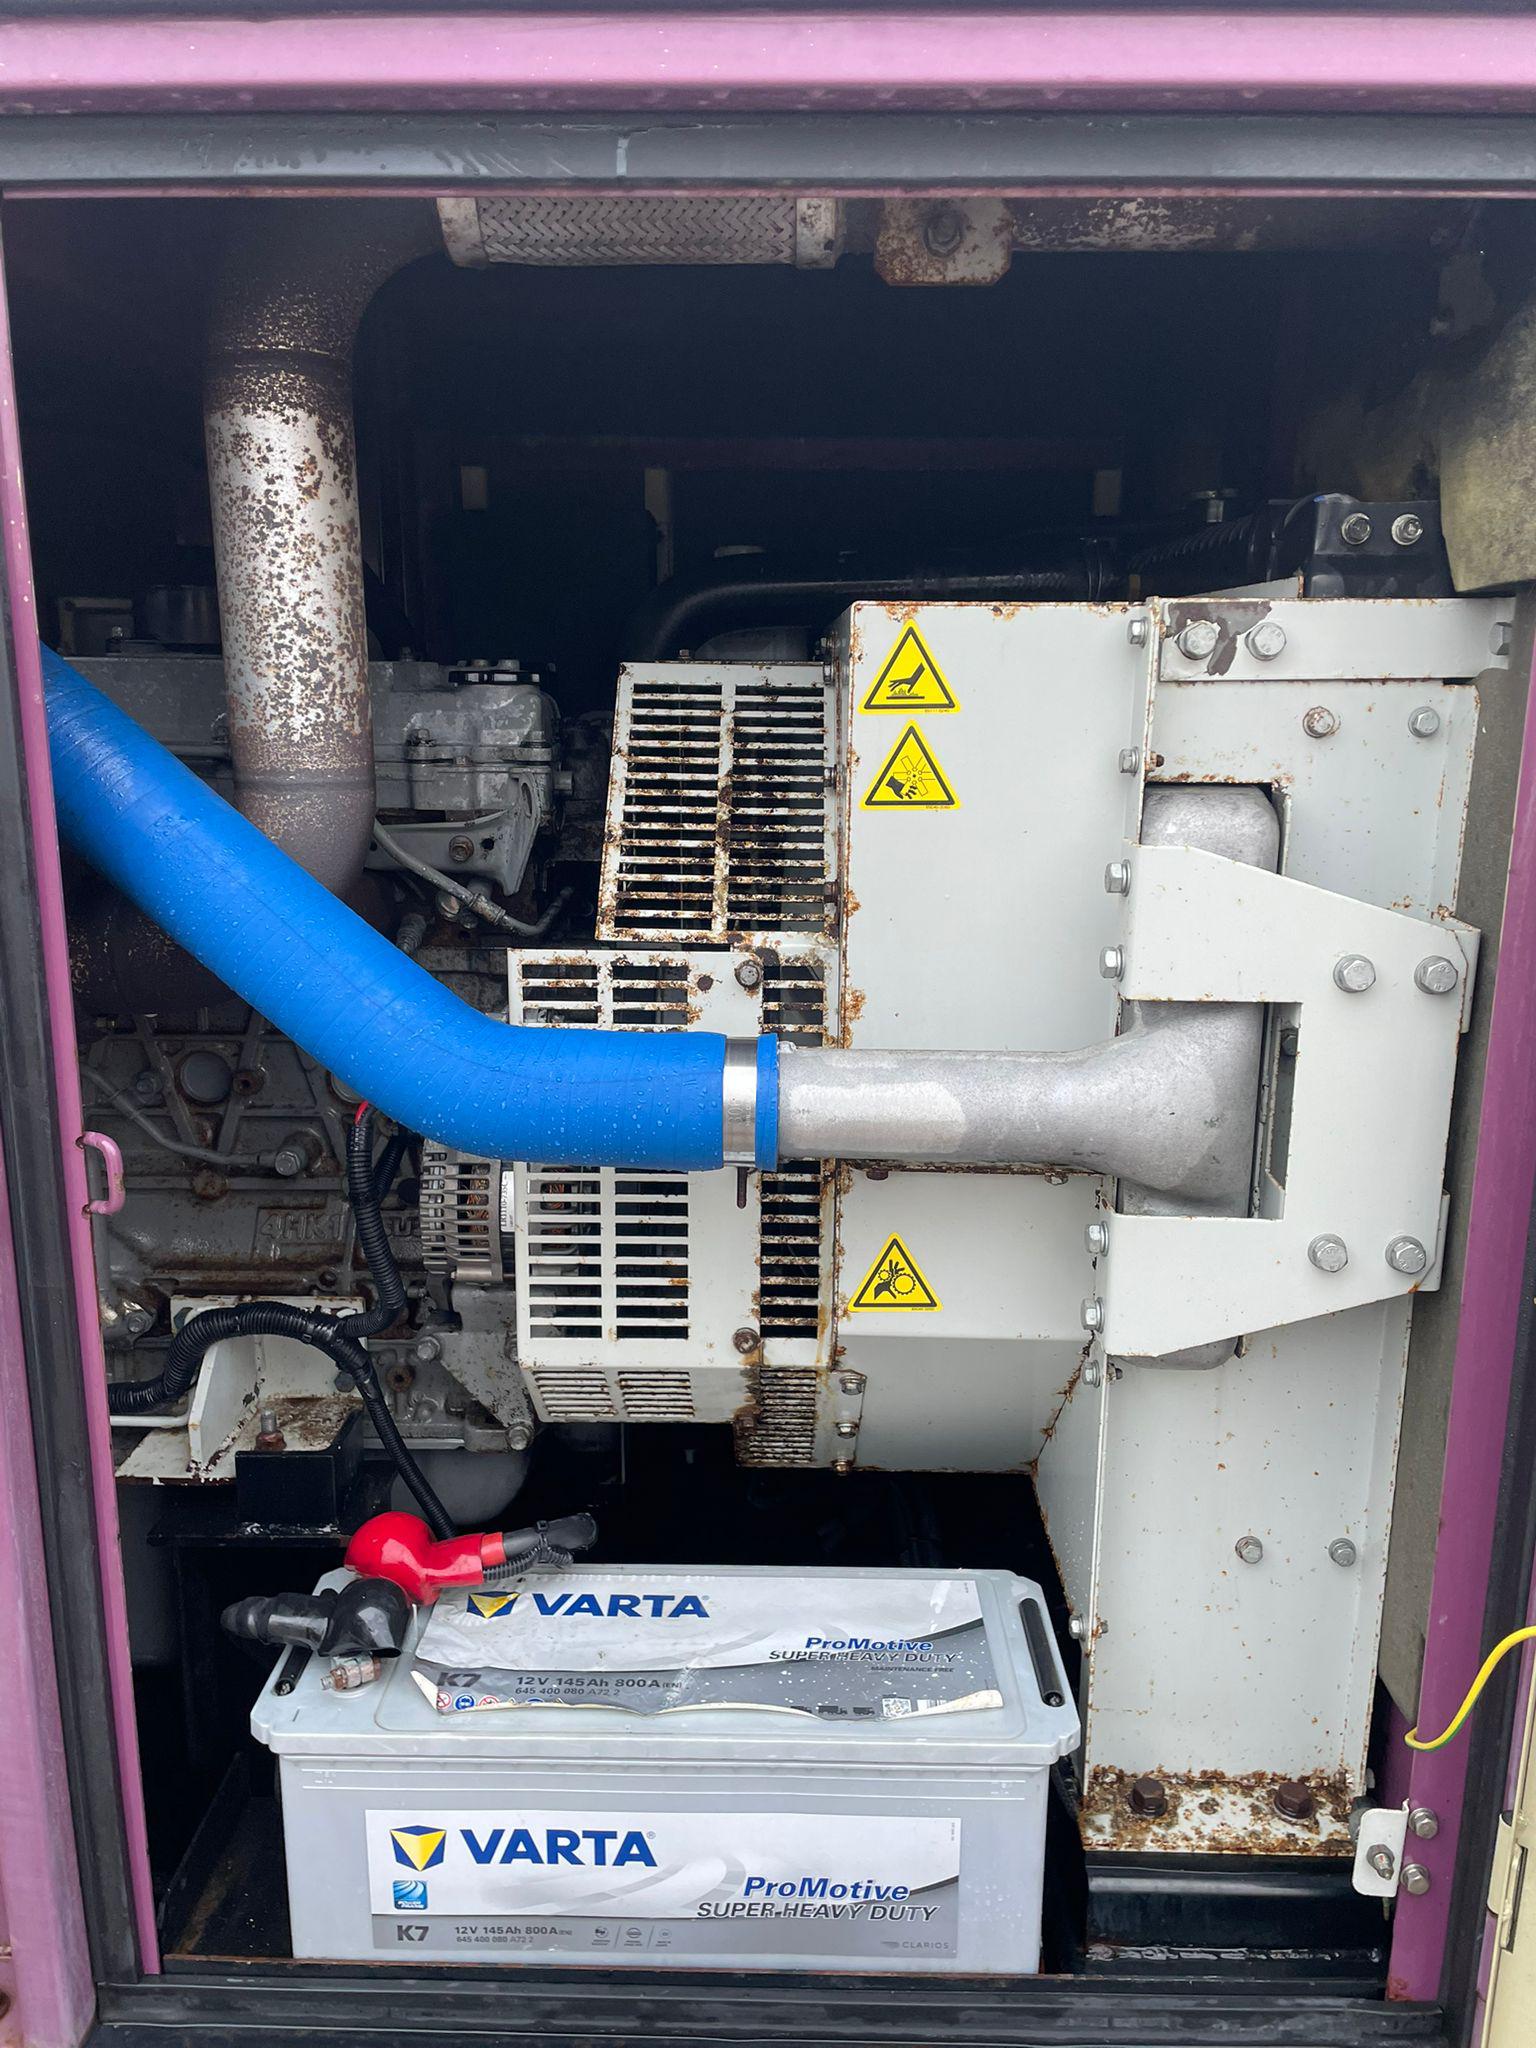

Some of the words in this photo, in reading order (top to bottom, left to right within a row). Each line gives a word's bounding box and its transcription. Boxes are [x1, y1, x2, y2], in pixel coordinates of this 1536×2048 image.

[532, 1593, 710, 1618] VARTA
[805, 1637, 933, 1651] ProMotive
[769, 1650, 831, 1661] SUPER
[837, 1651, 899, 1662] HEAVY
[904, 1652, 957, 1663] DUTY
[436, 1671, 482, 1688] K7
[516, 1676, 550, 1686] 12V
[556, 1677, 609, 1688] 145Ah
[515, 1687, 536, 1695] 645
[539, 1687, 560, 1695] 400
[459, 1829, 659, 1868] VARTA
[743, 1876, 910, 1901] ProMotive
[697, 1902, 775, 1917] SUPER
[783, 1903, 864, 1919] HEAVY
[869, 1905, 938, 1921] DUTY
[396, 1925, 430, 1941] K7
[454, 1926, 478, 1935] 12V
[483, 1926, 521, 1935] 145Ah
[902, 1941, 950, 1950] CLARIOS
